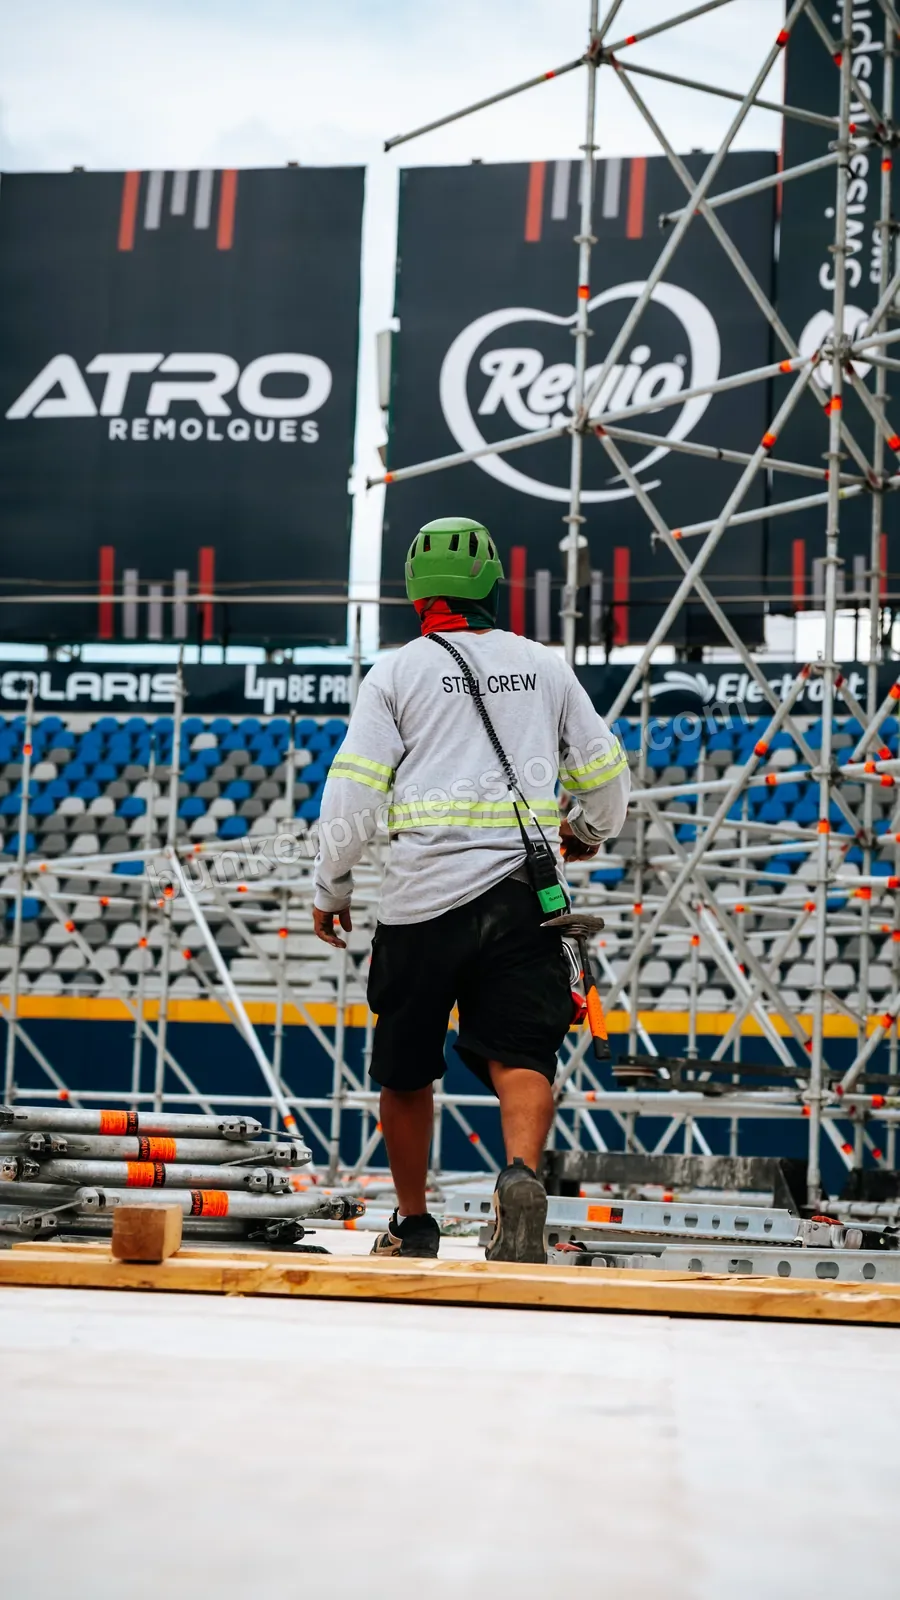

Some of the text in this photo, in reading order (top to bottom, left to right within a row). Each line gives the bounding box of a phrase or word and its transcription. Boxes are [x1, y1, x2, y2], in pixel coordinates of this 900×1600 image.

[5, 353, 332, 419] ATRO
[109, 418, 319, 443] REMOLQUES
[287, 674, 316, 703] BE
[487, 673, 537, 694] CREW
